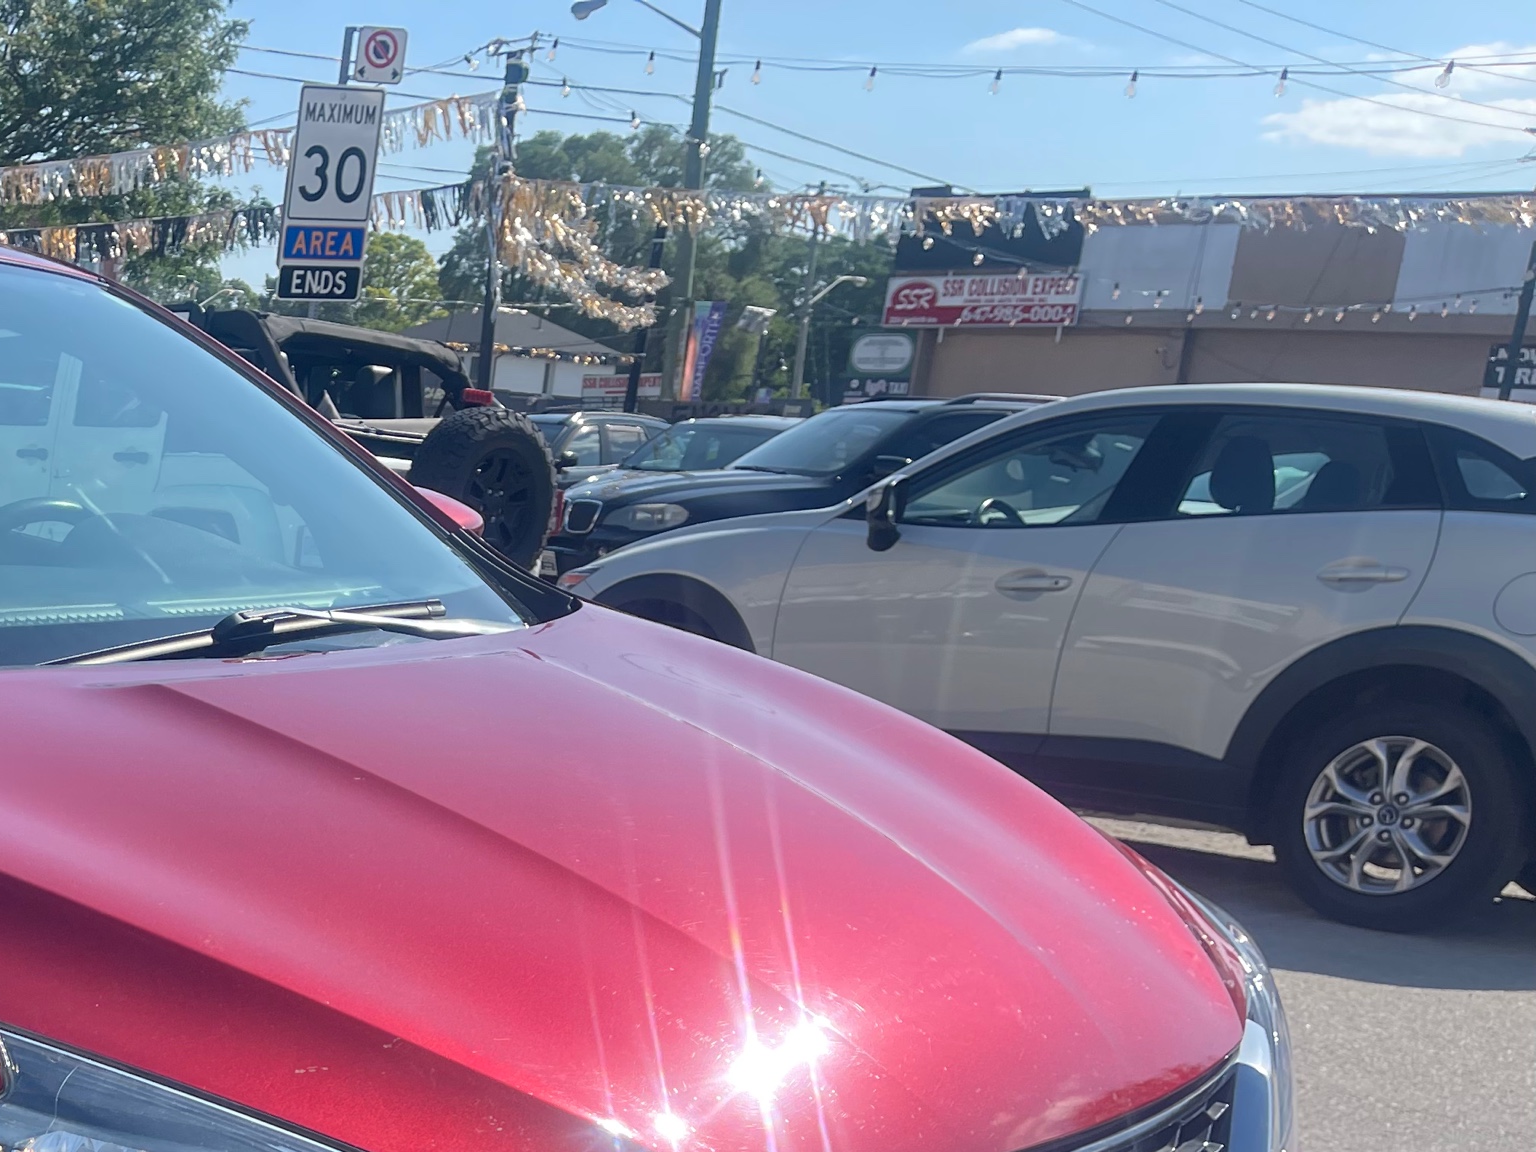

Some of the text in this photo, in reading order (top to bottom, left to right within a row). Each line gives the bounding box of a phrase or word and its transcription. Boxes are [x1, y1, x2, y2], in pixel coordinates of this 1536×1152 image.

[305, 102, 378, 125] MAXIMUM
[298, 145, 367, 203] 30
[292, 230, 354, 256] AREA
[290, 270, 347, 294] ENDS
